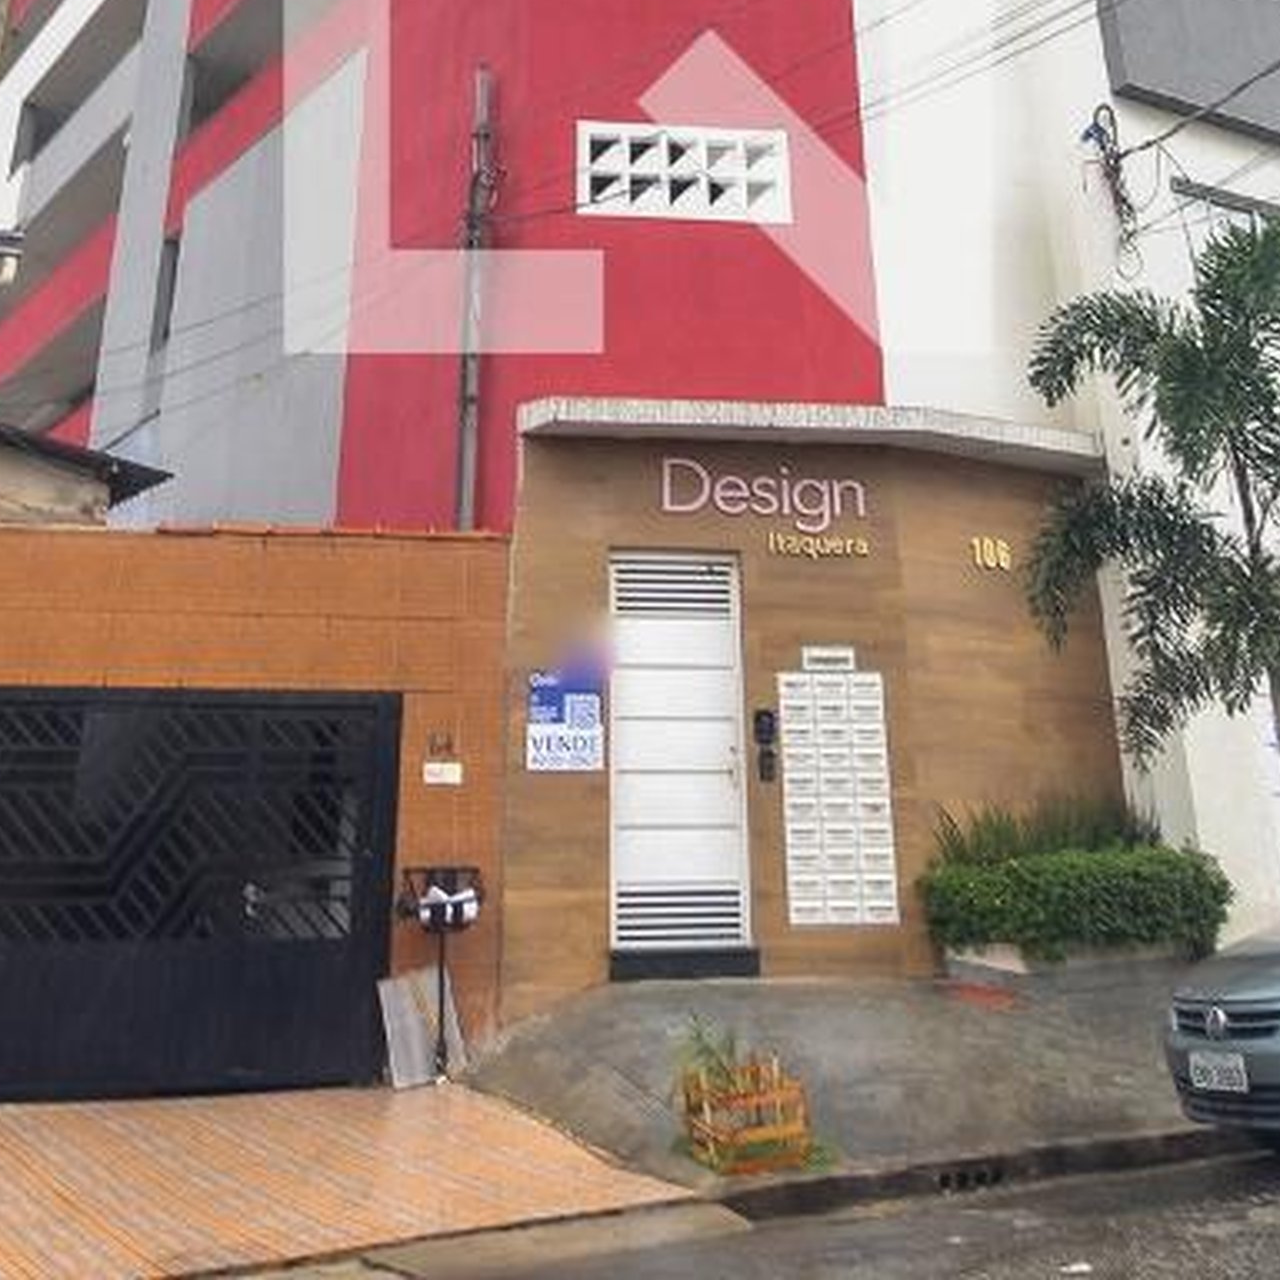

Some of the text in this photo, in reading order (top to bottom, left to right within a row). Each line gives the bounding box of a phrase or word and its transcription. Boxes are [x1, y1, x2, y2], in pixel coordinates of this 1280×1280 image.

[662, 457, 865, 533] Design
[769, 532, 869, 560] Itaquera
[970, 535, 1012, 571] 106
